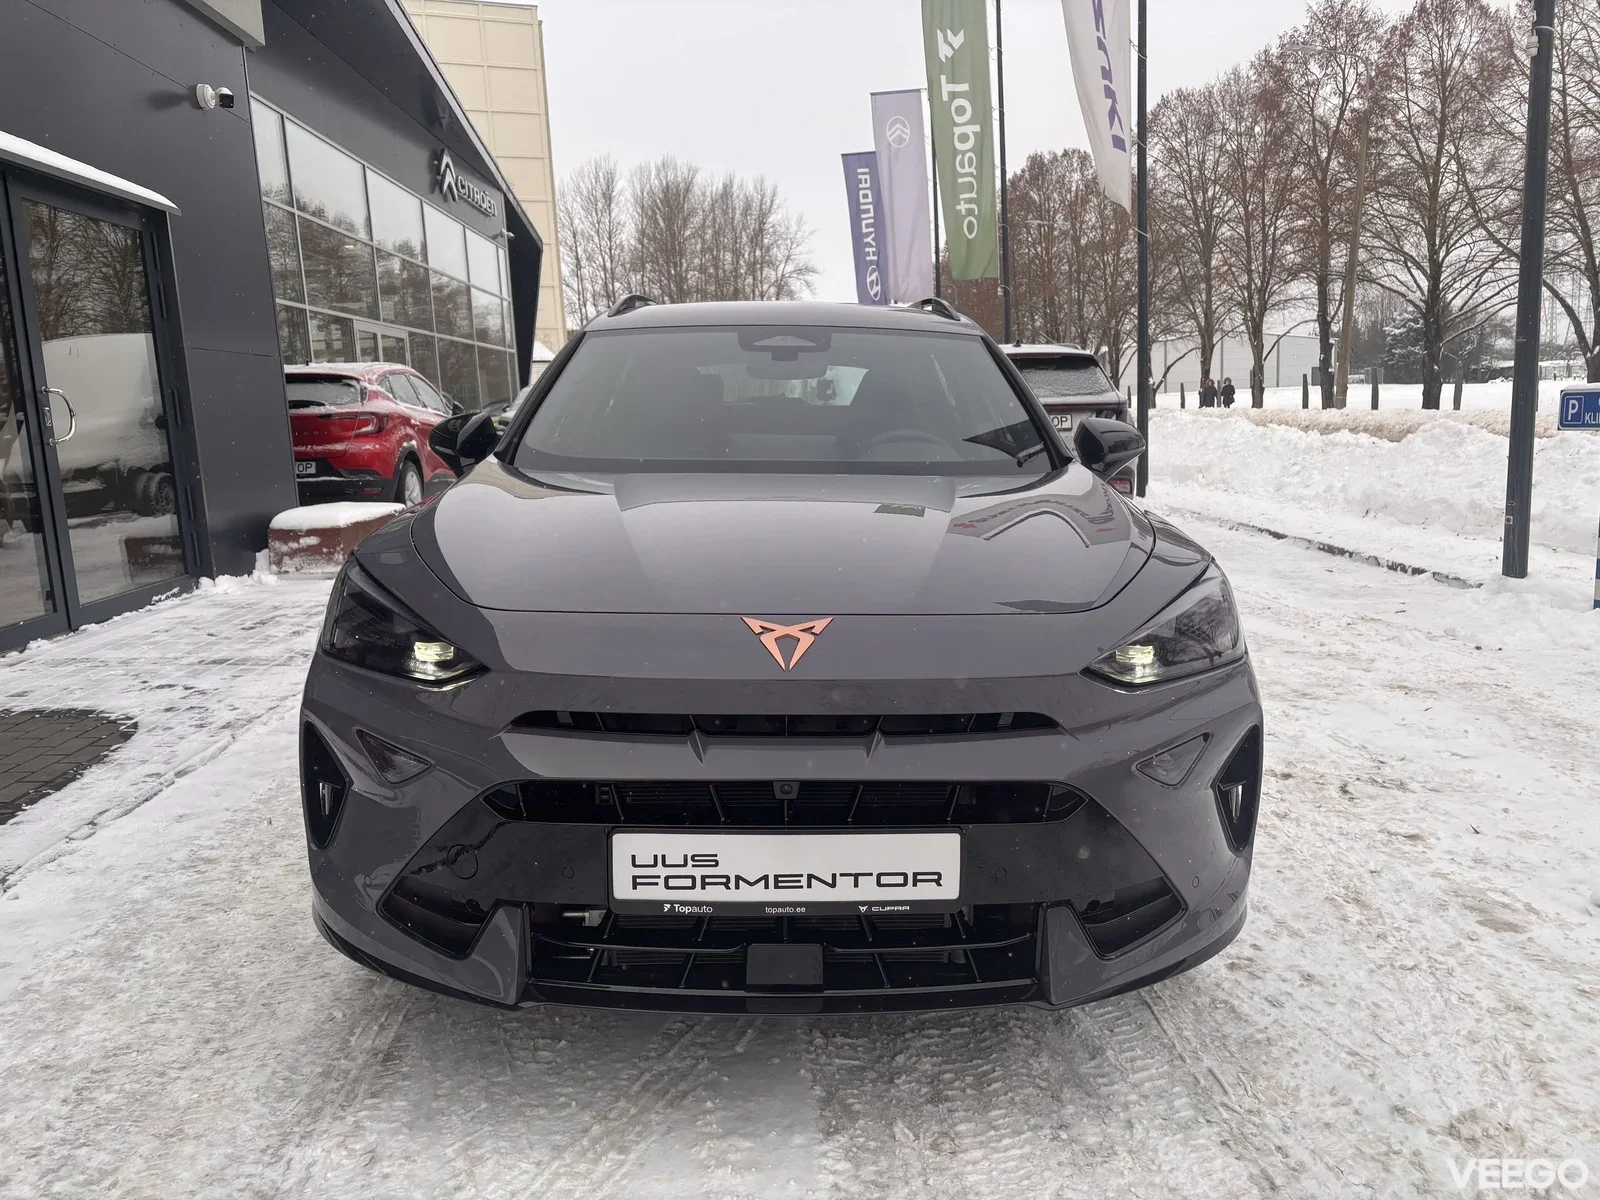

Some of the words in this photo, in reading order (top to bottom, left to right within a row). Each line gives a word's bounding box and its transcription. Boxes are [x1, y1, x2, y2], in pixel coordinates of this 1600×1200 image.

[1567, 399, 1579, 421] P
[295, 462, 313, 473] OP
[630, 853, 720, 869] UUS
[631, 871, 944, 891] FORMENTOR
[673, 903, 713, 914] Topauto
[765, 905, 806, 914] topauto.ee
